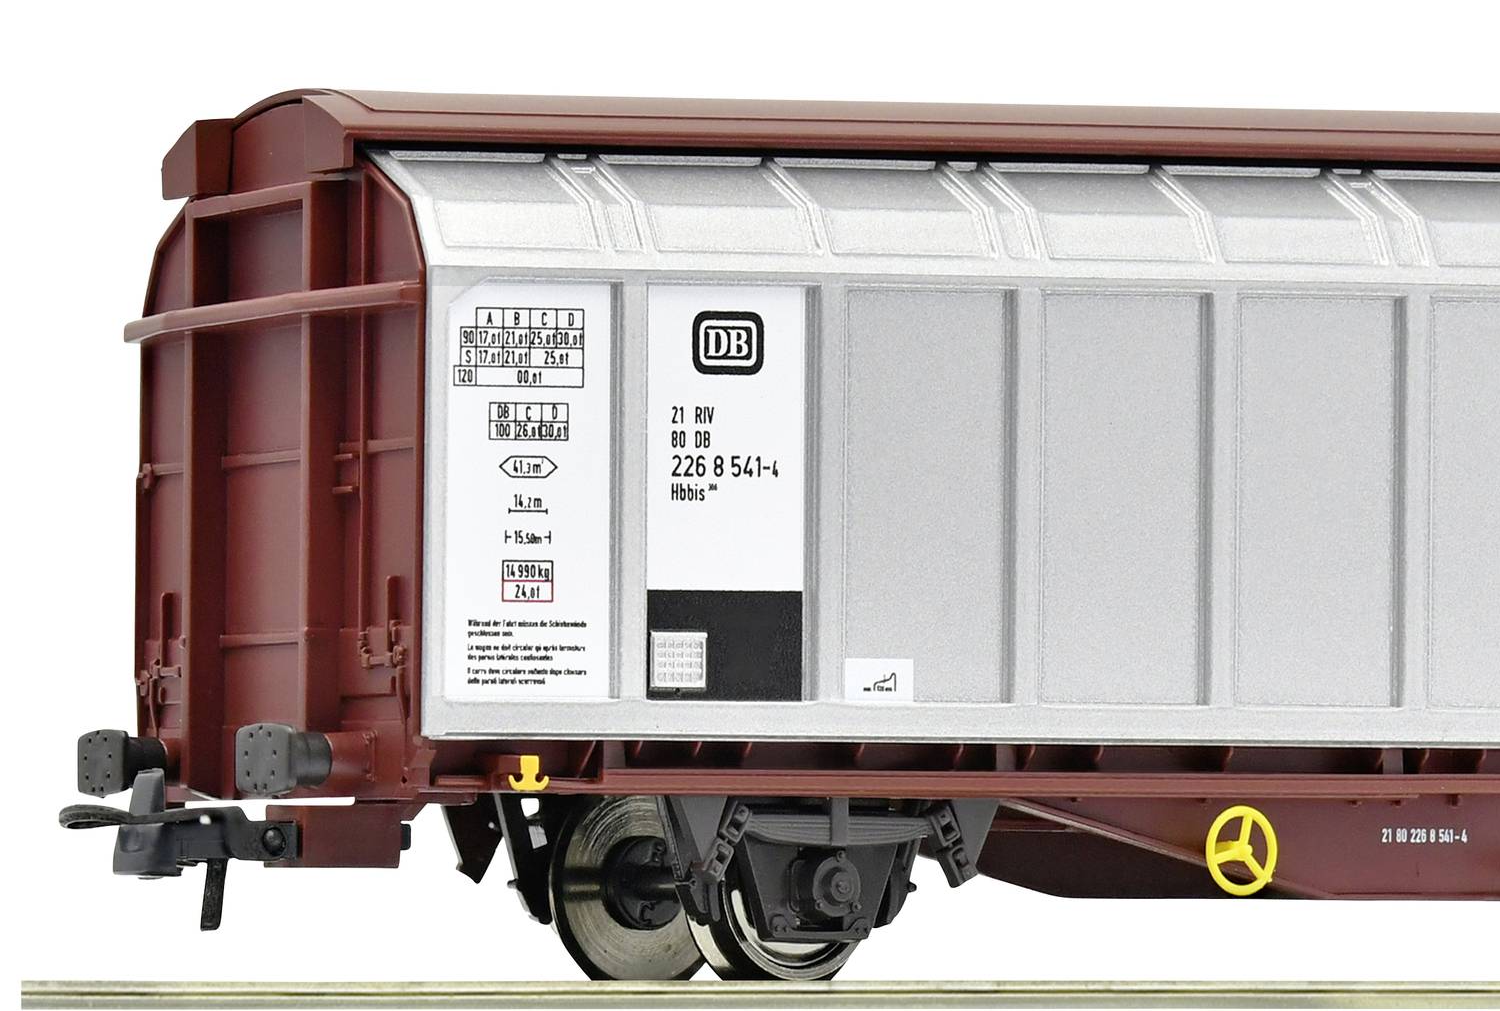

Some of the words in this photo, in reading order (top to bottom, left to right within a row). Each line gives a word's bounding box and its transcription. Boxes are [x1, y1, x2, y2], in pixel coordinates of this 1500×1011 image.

[487, 312, 493, 325] A
[514, 312, 520, 326] B
[542, 313, 547, 326] C
[569, 313, 574, 326] D
[463, 331, 474, 344] 90
[706, 328, 750, 358] DB
[466, 350, 471, 363] S
[458, 369, 473, 383] 120
[498, 405, 509, 419] DB
[526, 406, 531, 420] C
[552, 406, 557, 420] D
[672, 406, 683, 424] 21
[695, 406, 714, 424] RIV
[495, 424, 510, 437] 100
[672, 430, 685, 448] 80
[695, 431, 710, 448] DB
[672, 455, 706, 477] 226
[714, 456, 723, 477] 8
[731, 456, 778, 477] 541-4
[672, 483, 705, 501] Hbbis
[518, 564, 536, 578] 990
[1382, 829, 1392, 843] 21
[1410, 829, 1426, 843] 226
